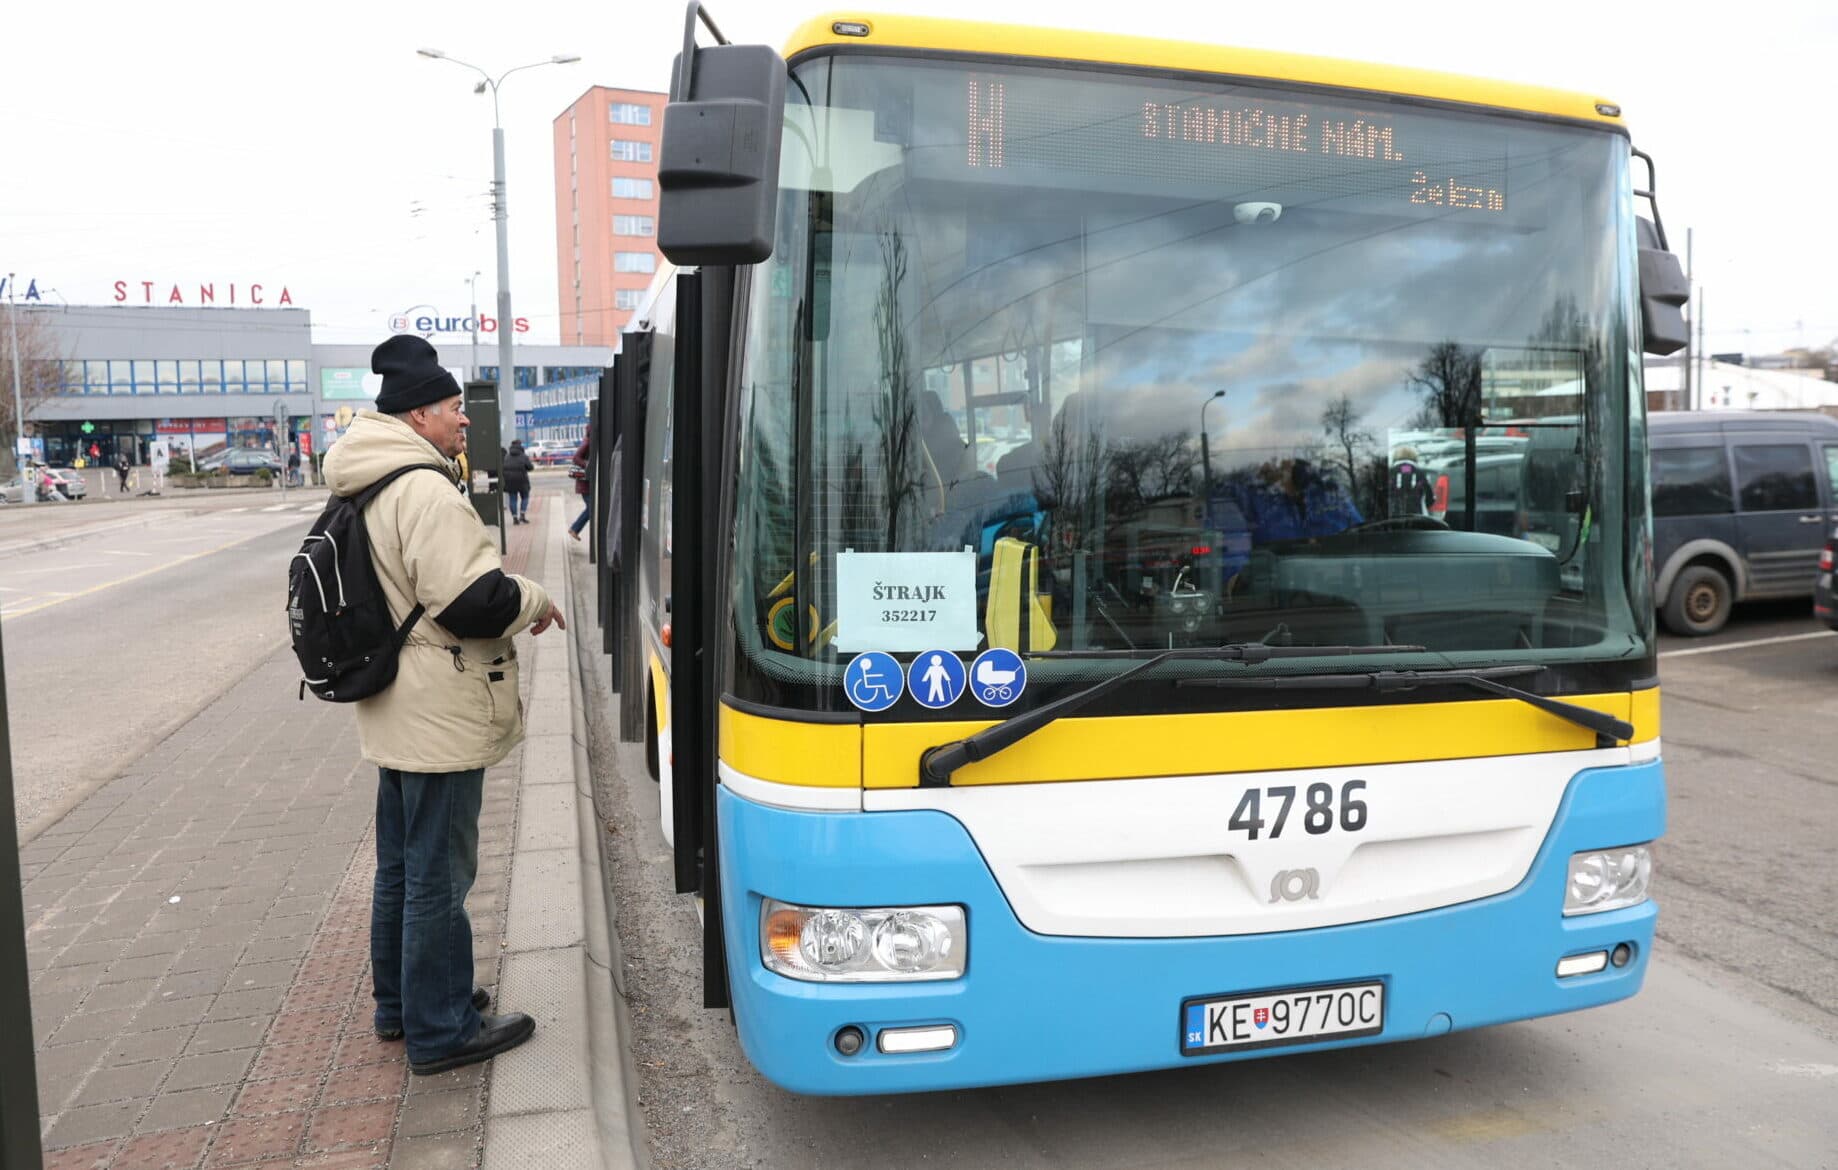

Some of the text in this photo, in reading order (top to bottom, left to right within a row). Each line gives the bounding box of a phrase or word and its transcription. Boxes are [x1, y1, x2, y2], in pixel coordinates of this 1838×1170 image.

[968, 81, 1003, 168] H
[114, 280, 293, 305] STANICA
[416, 313, 530, 334] eurobs
[872, 581, 946, 603] ŠTRAJK
[881, 609, 937, 623] 352217
[1227, 779, 1368, 841] 4786
[1188, 1031, 1202, 1043] SK
